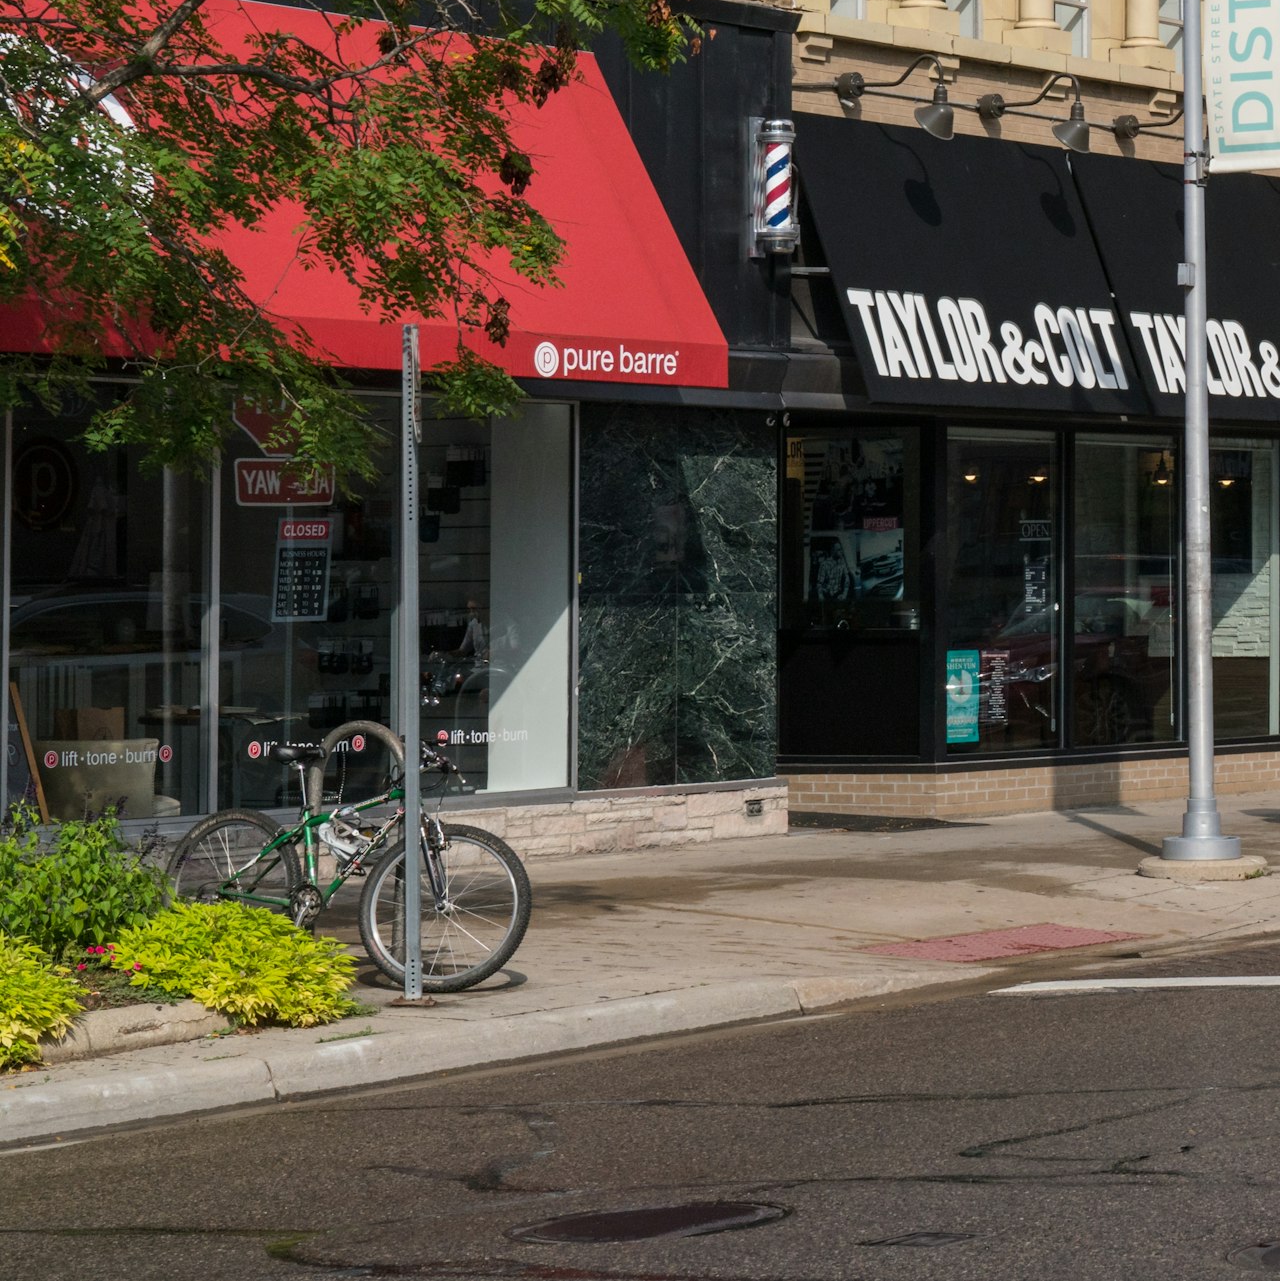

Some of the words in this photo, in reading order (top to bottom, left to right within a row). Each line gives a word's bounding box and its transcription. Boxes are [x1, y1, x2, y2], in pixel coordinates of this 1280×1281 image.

[1213, 75, 1225, 134] STATE
[563, 347, 615, 377] pure
[283, 524, 326, 537] CLOSED
